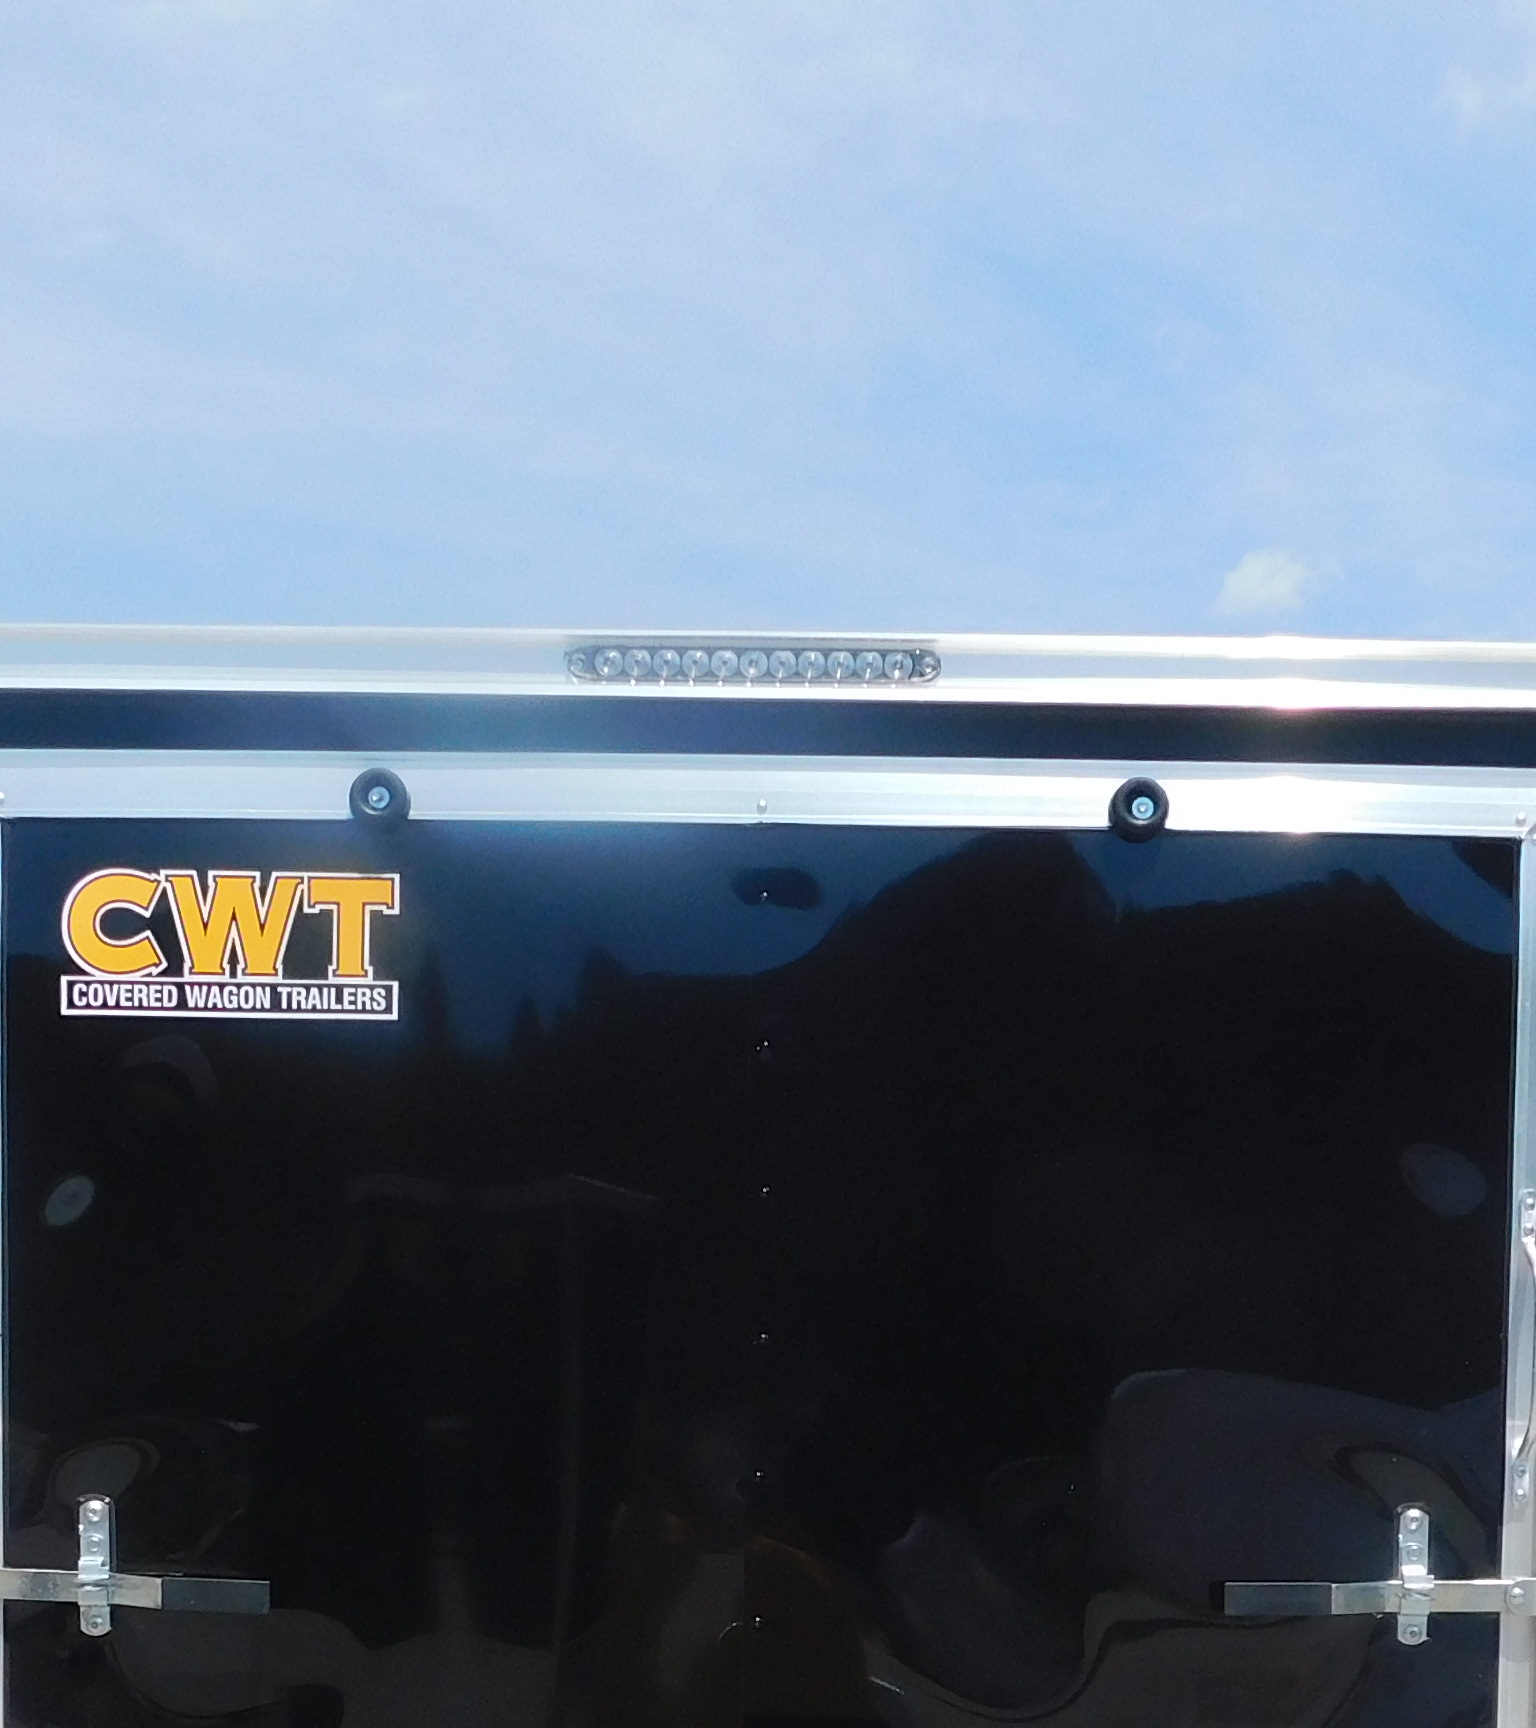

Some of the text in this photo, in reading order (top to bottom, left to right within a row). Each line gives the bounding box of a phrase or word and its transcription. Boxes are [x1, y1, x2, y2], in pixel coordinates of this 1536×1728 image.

[63, 869, 399, 979] CWT
[72, 983, 386, 1012] COVERED WAGON TRAILERS
